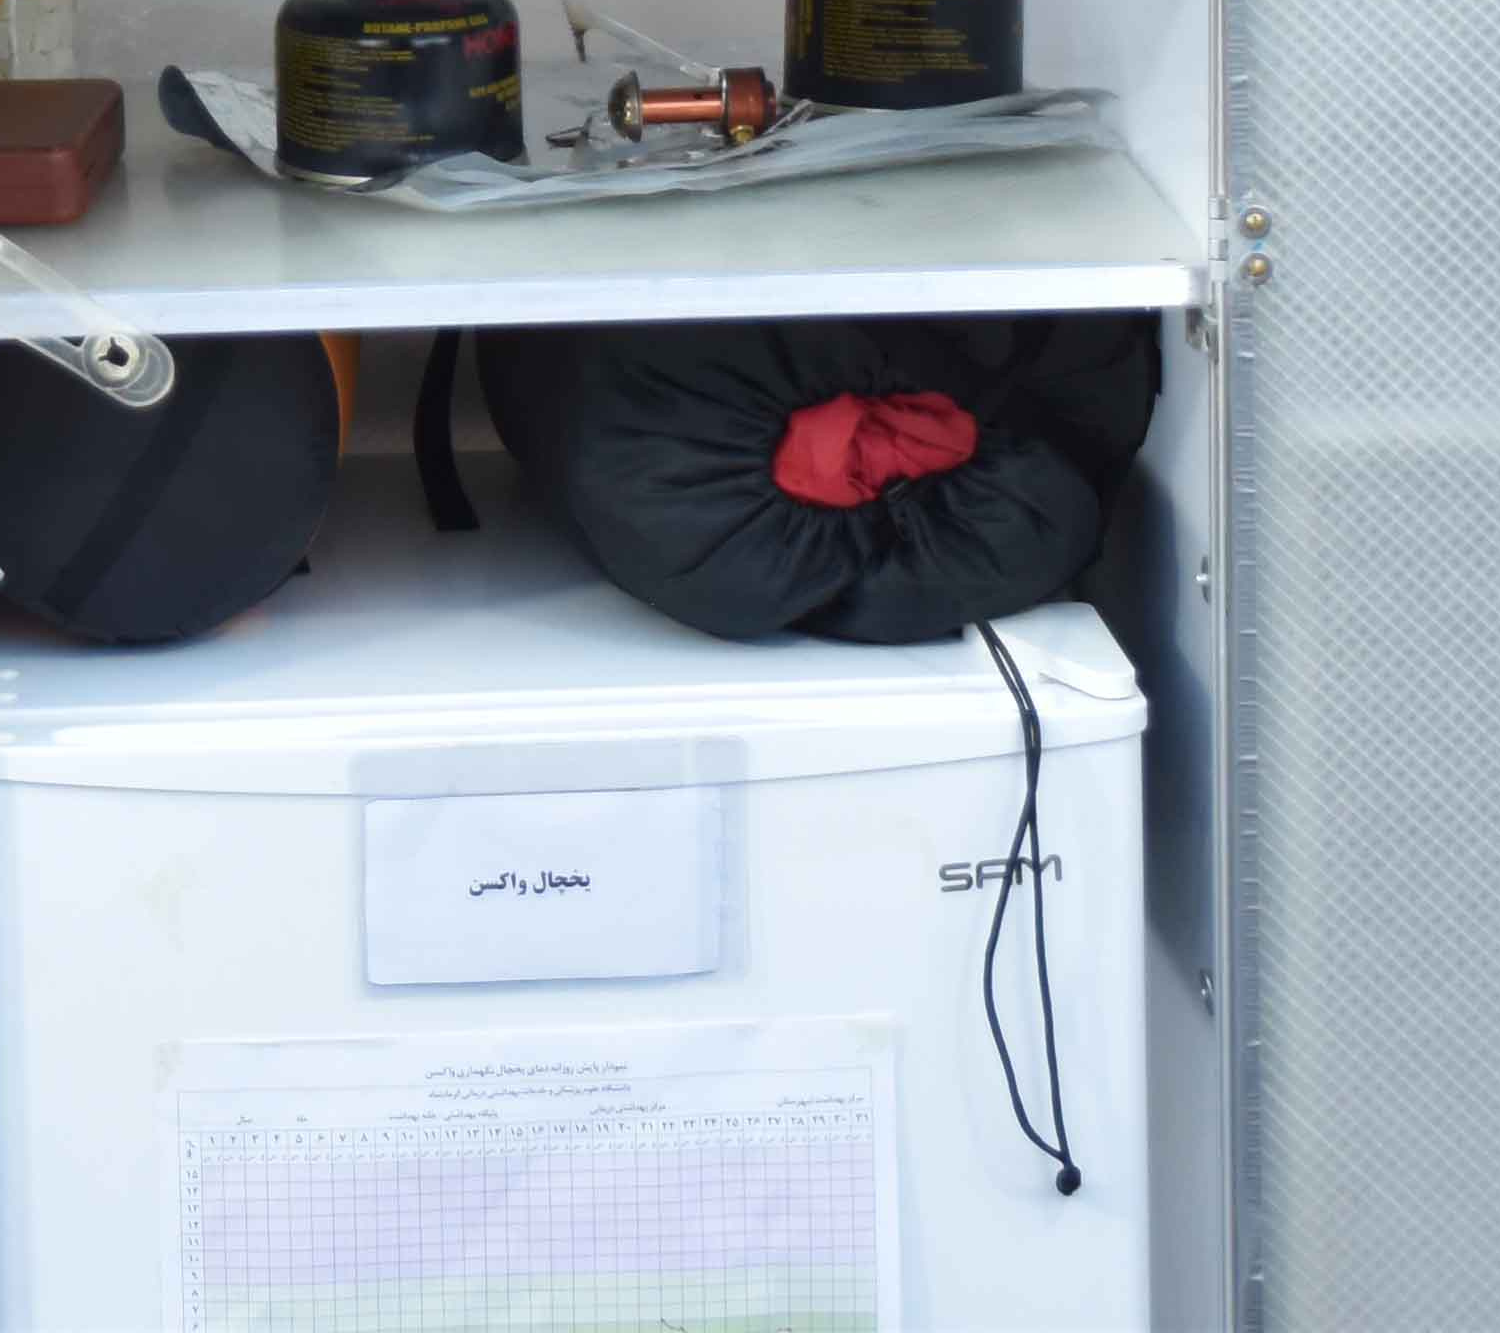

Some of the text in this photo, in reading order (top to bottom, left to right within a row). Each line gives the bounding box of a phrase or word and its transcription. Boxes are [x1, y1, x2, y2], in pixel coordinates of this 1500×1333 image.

[469, 869, 592, 896] یخچال واکسن
[938, 853, 1063, 893] SAM
